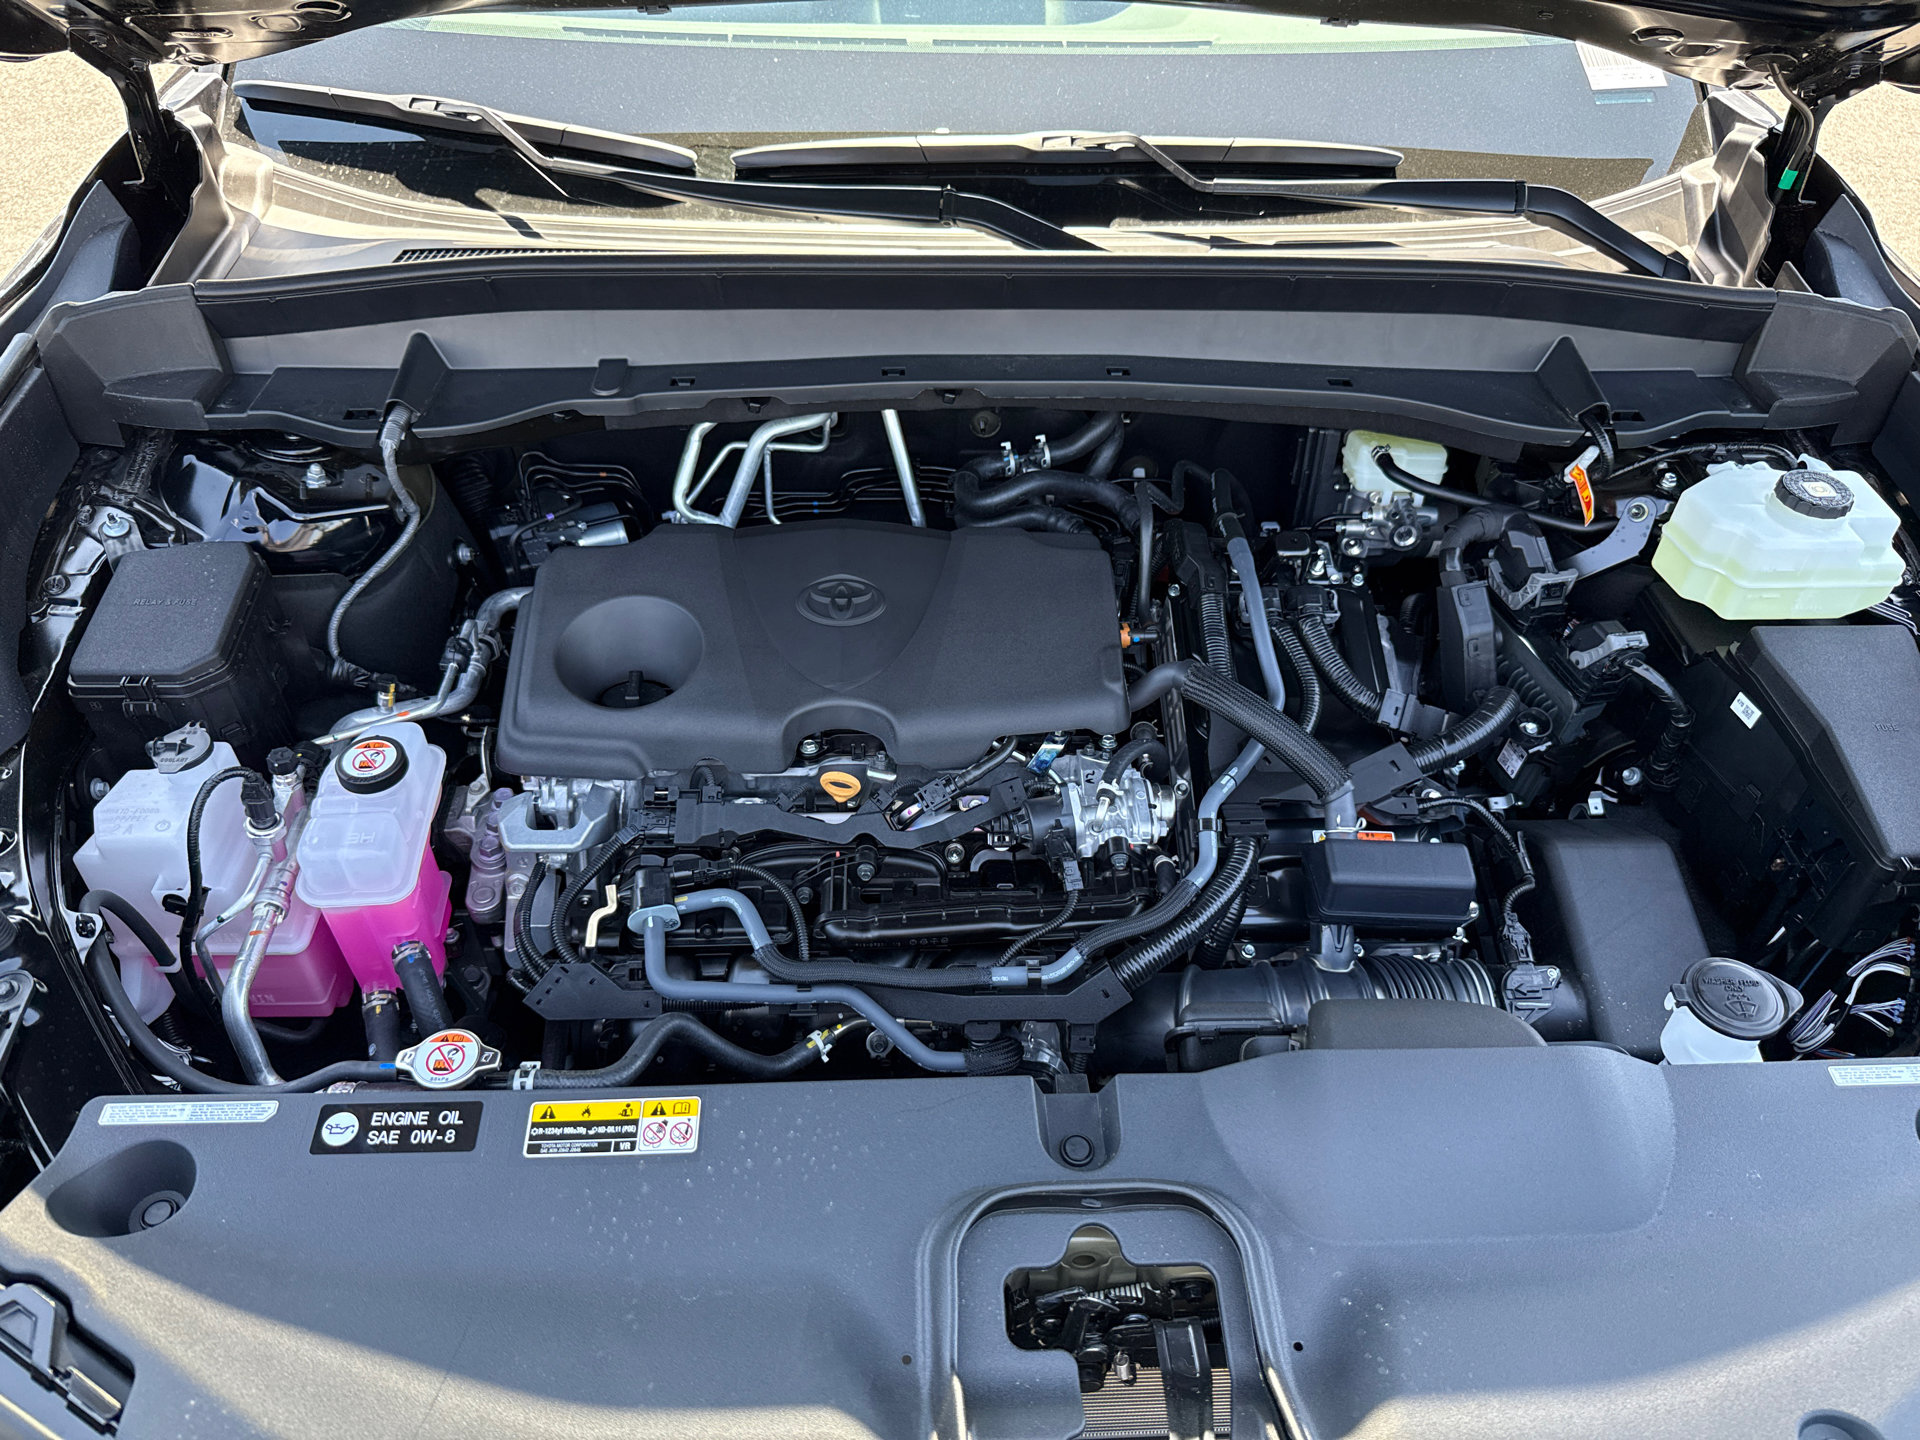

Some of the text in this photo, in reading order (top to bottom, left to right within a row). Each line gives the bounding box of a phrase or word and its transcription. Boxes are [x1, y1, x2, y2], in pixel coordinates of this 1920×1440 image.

[133, 598, 164, 606] RELAY
[370, 1110, 464, 1126] ENGINE OIL
[366, 1129, 456, 1145] SAE 0W-8
[619, 1142, 631, 1150] VR
